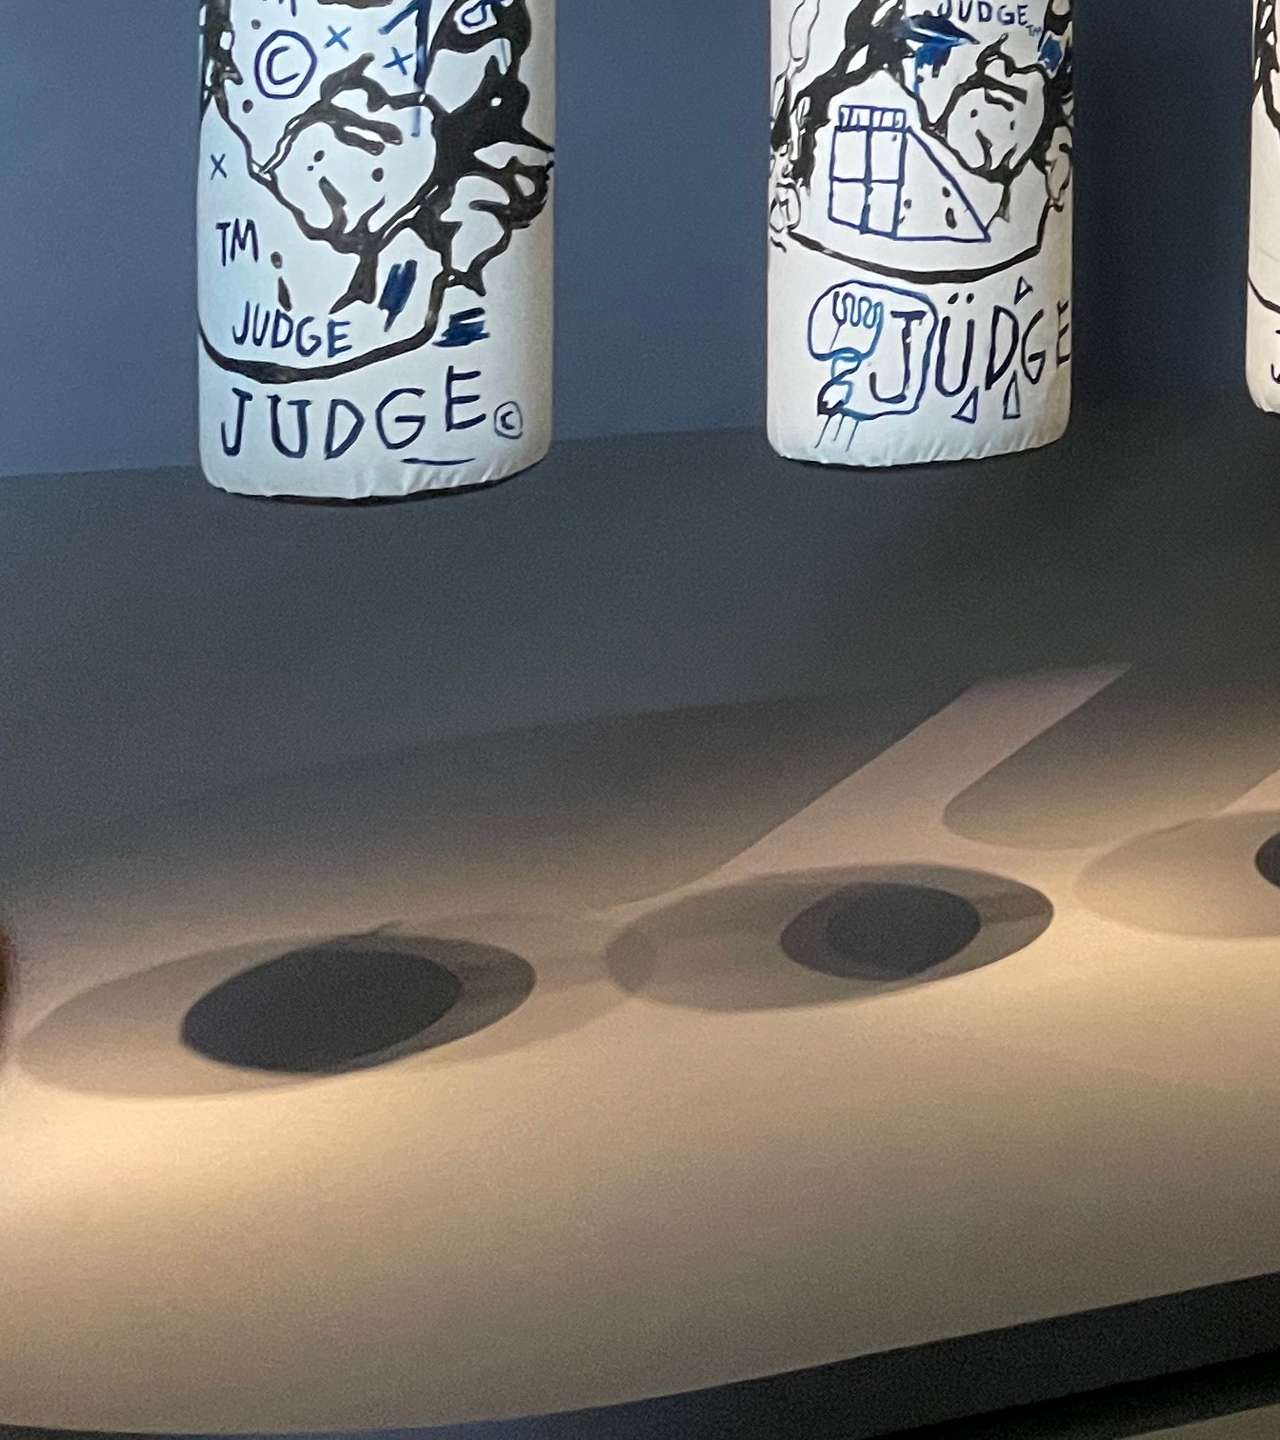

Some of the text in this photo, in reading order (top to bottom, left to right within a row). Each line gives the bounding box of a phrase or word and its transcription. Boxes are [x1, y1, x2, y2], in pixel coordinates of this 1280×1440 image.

[215, 217, 260, 267] TM
[231, 300, 353, 359] JUDGE
[220, 364, 488, 461] JUDGE
